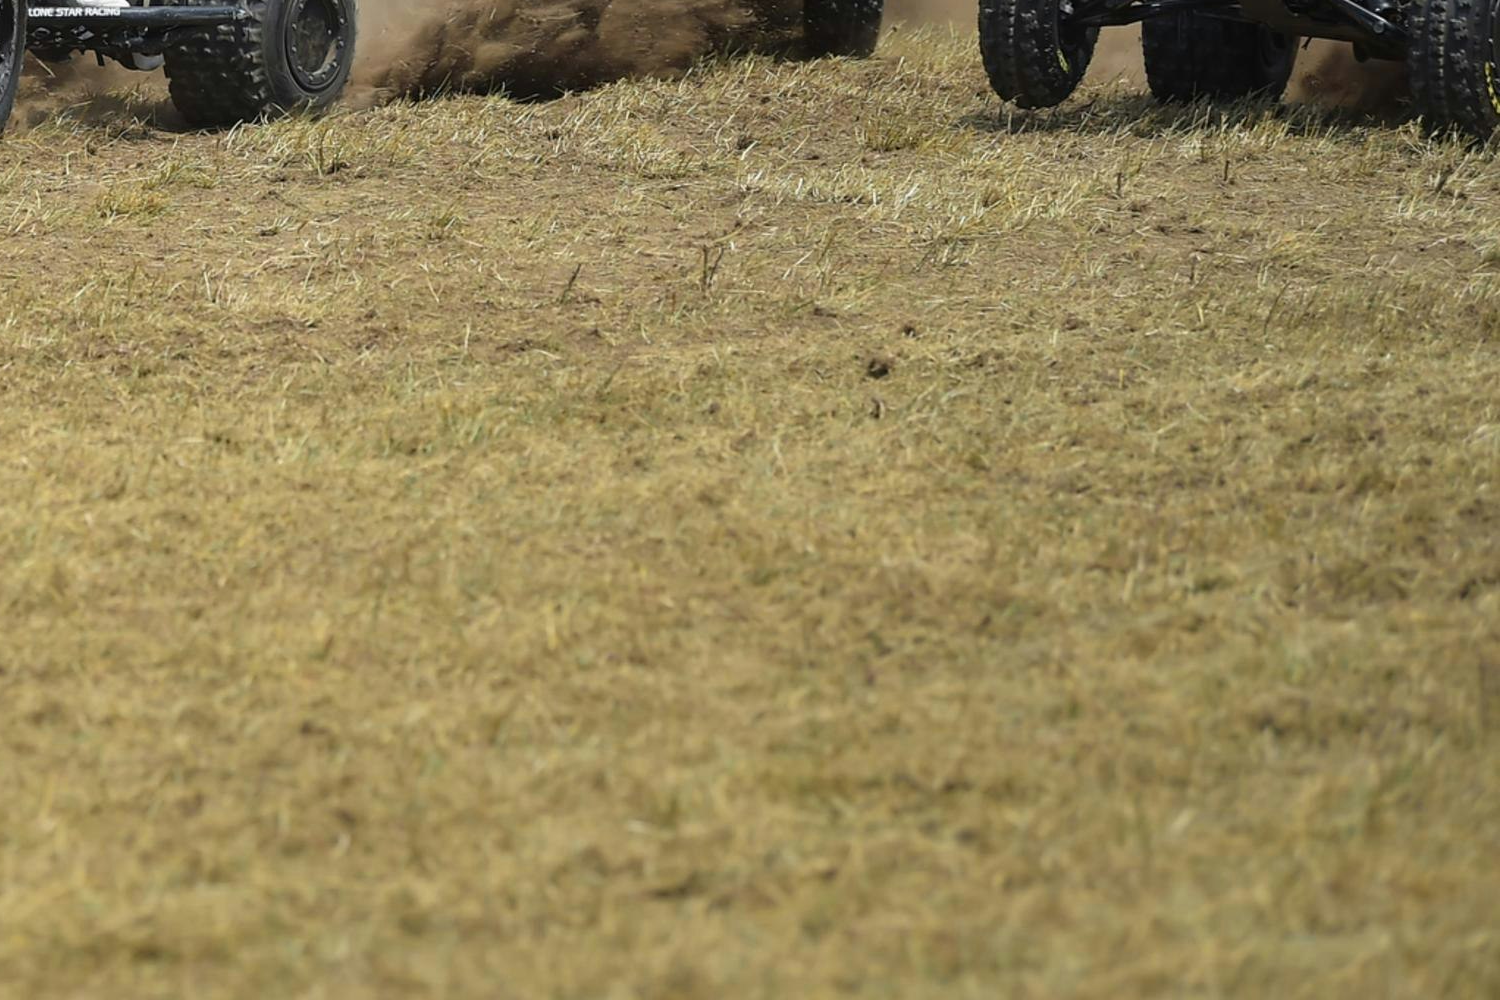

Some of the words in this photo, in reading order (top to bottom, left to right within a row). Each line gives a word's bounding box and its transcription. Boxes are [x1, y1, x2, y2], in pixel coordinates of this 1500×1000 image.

[28, 7, 54, 17] LONE
[55, 7, 83, 17] STAR
[84, 7, 121, 17] RACING
